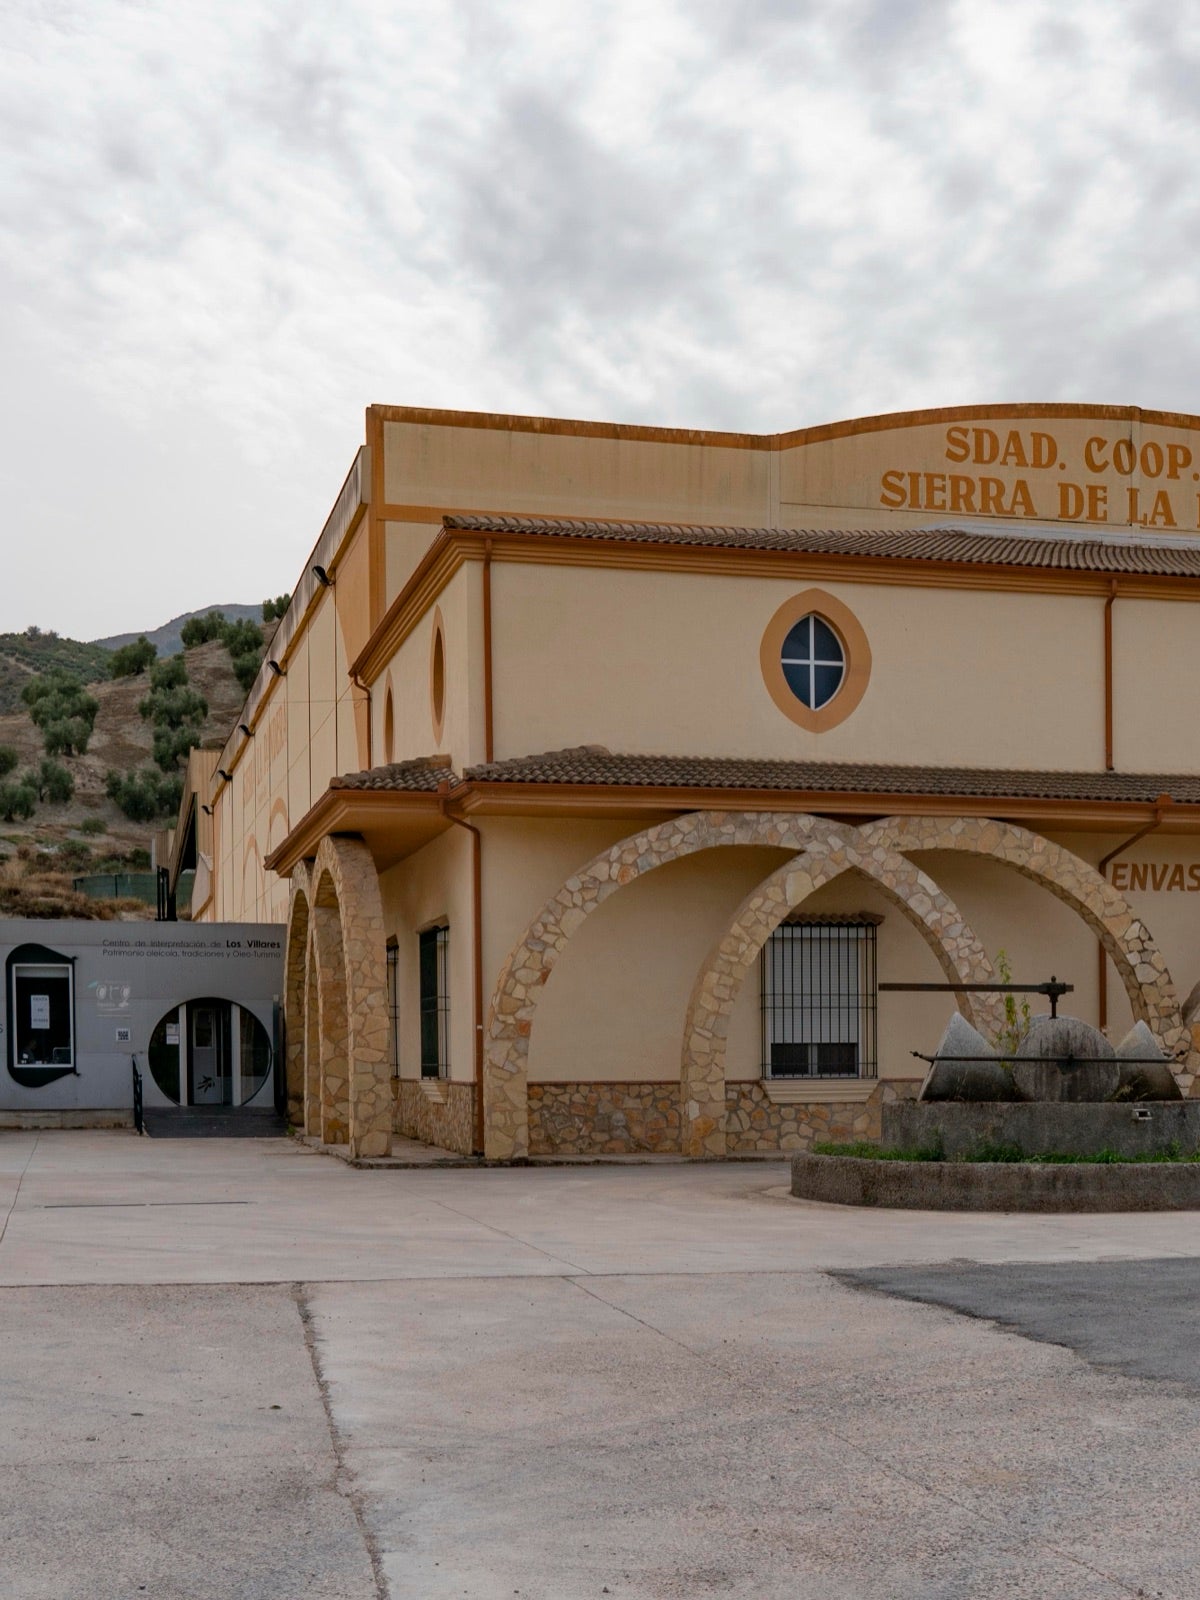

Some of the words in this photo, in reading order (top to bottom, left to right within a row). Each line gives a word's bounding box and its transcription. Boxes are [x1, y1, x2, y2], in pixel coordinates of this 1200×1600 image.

[944, 426, 1067, 471] SDAD.
[1084, 435, 1200, 482] COOP.
[880, 469, 1038, 518] SIERRA
[1057, 482, 1108, 524] DE
[1127, 487, 1178, 528] LA
[102, 939, 131, 948] Centro
[134, 939, 146, 948] de
[209, 941, 222, 949] de
[226, 939, 241, 949] Los
[247, 939, 281, 949] Villares
[102, 949, 145, 957] Patrimonio
